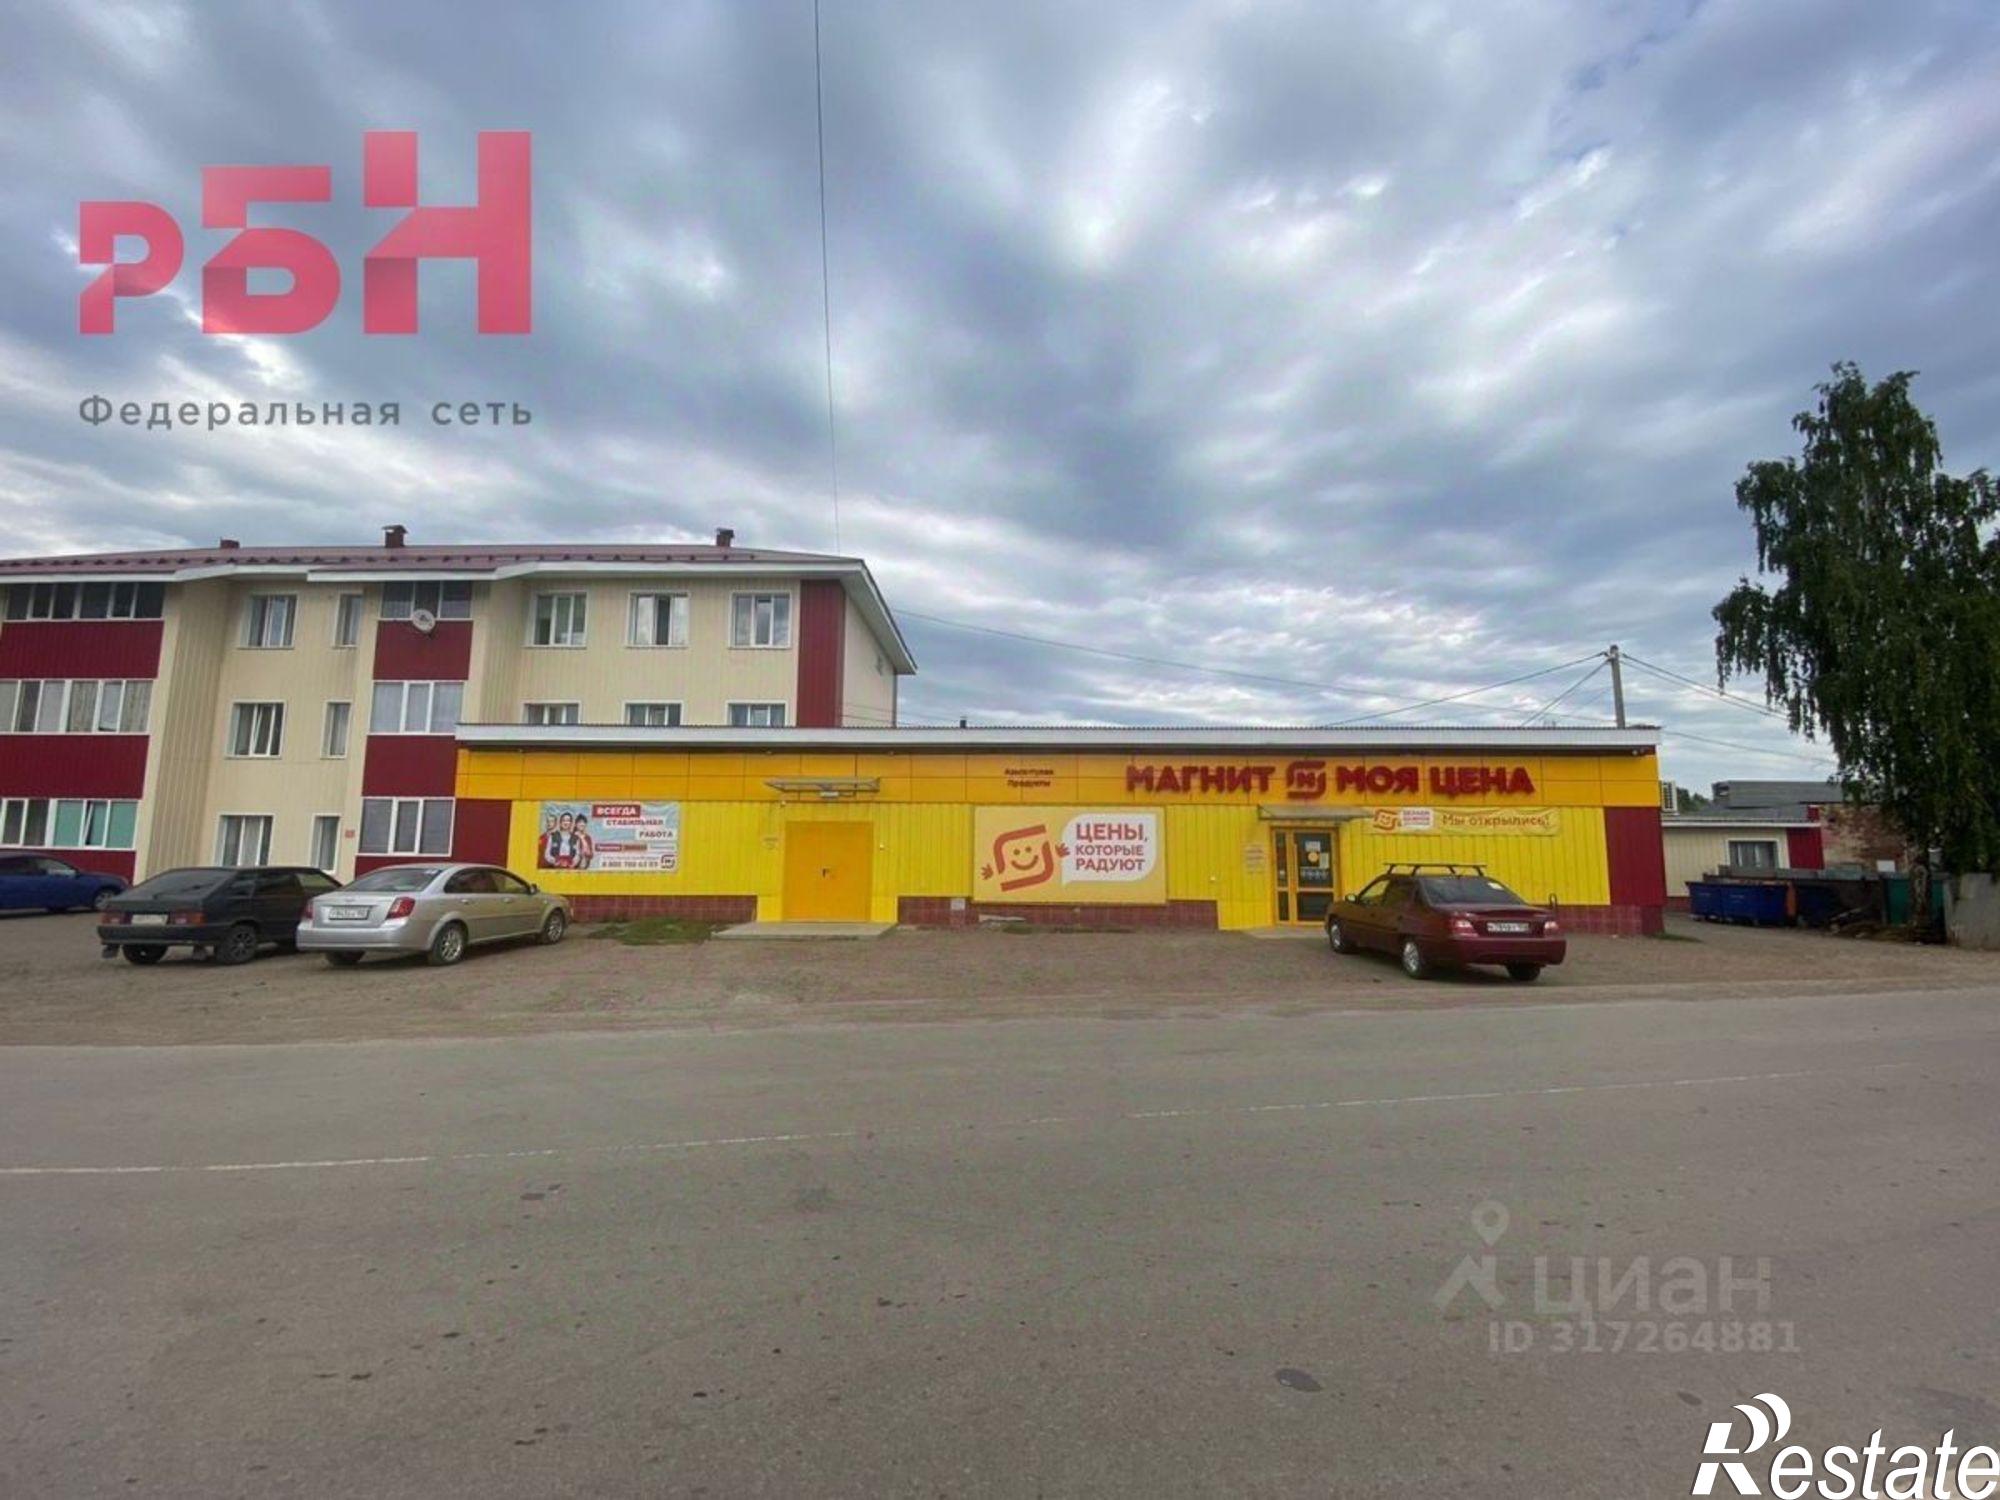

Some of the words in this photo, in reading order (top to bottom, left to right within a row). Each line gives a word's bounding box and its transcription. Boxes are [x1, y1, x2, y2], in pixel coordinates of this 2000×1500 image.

[1126, 765, 1276, 794] МАГНИТ
[1336, 765, 1420, 795] МОЯ
[1429, 766, 1536, 800] ЦЕНА
[596, 806, 637, 817] ВСЕГДА
[1442, 814, 1466, 826] Мы
[1076, 823, 1149, 842] ЦЕНЫ,
[1075, 845, 1144, 856] КОТОРЫЕ
[1075, 859, 1146, 873] РАДУЮТ
